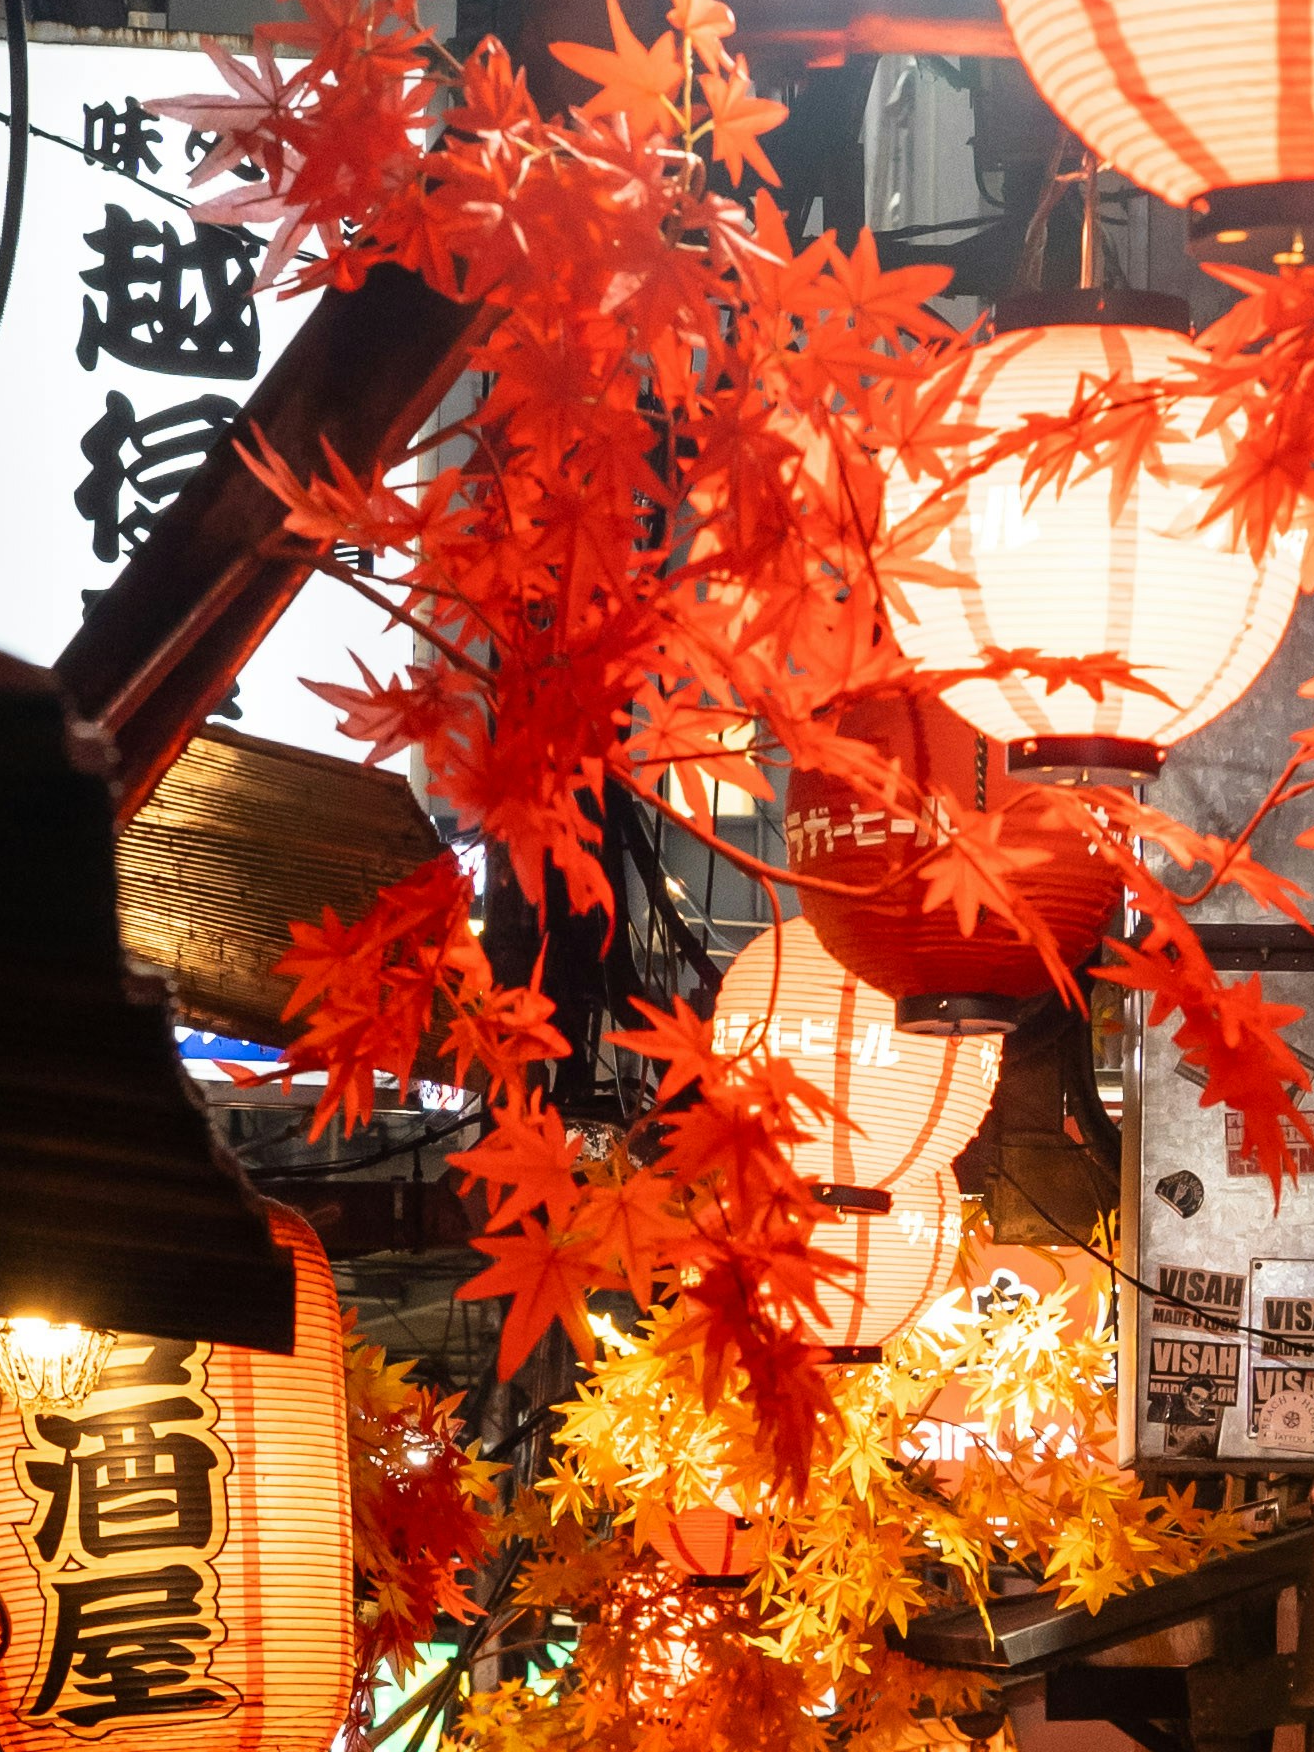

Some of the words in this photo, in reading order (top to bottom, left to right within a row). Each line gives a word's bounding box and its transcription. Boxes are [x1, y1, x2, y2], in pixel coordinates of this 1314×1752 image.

[1159, 1268, 1243, 1308] VISAH
[1153, 1341, 1237, 1378] VISAH
[23, 1342, 227, 1727] 酒屋
